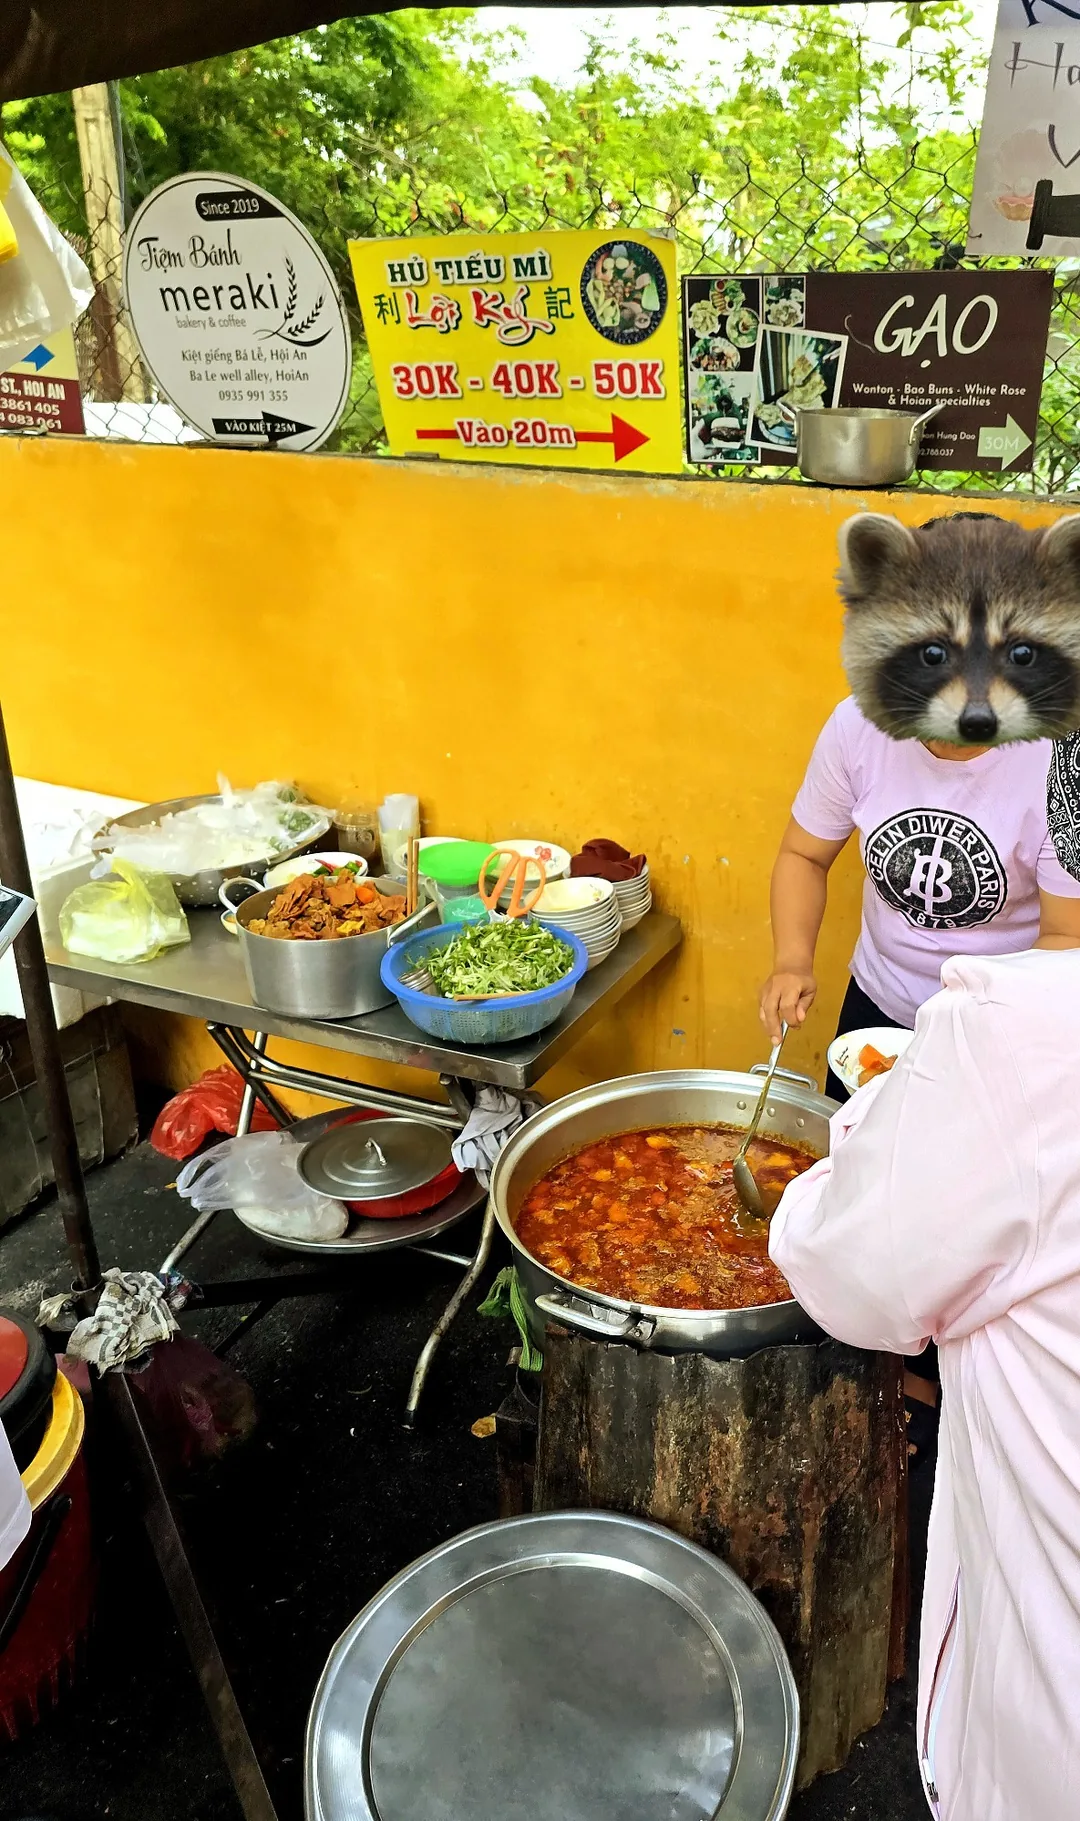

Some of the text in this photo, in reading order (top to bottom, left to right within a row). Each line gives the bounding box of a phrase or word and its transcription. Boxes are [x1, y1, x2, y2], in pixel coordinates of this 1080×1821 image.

[200, 198, 260, 216] Since 2019
[138, 228, 242, 273] Tiệm Bánh
[387, 252, 549, 282] HỦ TIẾU MÌ
[159, 272, 279, 312] meraki
[374, 292, 400, 325] 利
[543, 286, 575, 320] 記
[175, 314, 247, 330] bakery & coffee
[471, 285, 553, 343] Ký
[874, 293, 998, 368] GẠO
[181, 349, 201, 365] Kiệt
[204, 348, 233, 365] giếng
[270, 348, 290, 364] Hội
[292, 349, 307, 361] An
[189, 368, 309, 384] Ba Le well alley, HoiAn
[392, 363, 460, 396] 30K
[492, 362, 561, 396] 40K
[593, 362, 663, 395] 50K
[23, 379, 45, 398] HOI
[47, 383, 65, 401] AN
[218, 390, 288, 401] 0935 991 355
[852, 383, 894, 394] Wonton
[904, 383, 925, 394] Bao
[928, 383, 953, 394] Buns
[965, 384, 996, 395] White
[1000, 384, 1026, 396] Rose
[0, 397, 60, 416] 3861 405
[888, 394, 991, 407] & Hoian specialties
[7, 413, 34, 426] 083
[225, 419, 297, 435] VÀO KIỆT 25M
[457, 420, 574, 445] Vào 20m
[936, 431, 958, 441] Hung
[960, 431, 976, 440] Dao
[984, 436, 1020, 450] 30M
[908, 815, 979, 850] DIWER
[971, 850, 999, 910] PARIS
